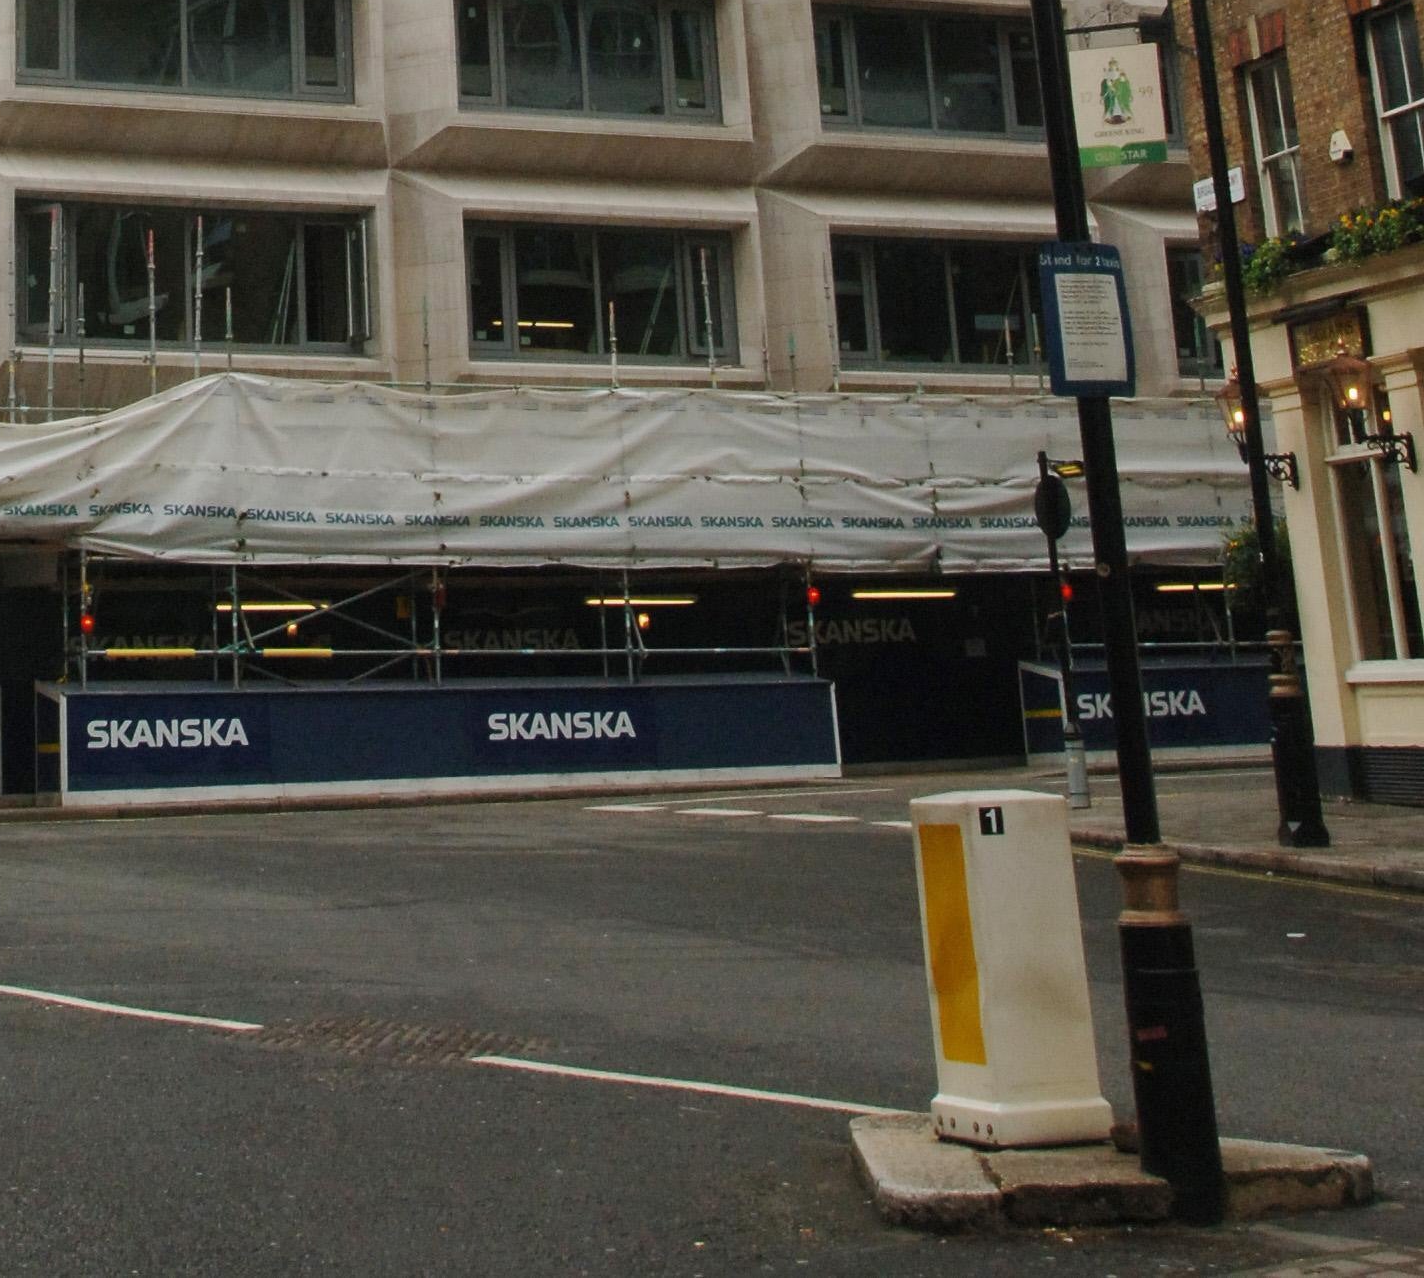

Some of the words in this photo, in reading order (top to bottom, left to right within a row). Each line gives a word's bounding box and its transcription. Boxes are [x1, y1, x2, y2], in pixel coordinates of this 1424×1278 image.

[1120, 149, 1148, 160] STAR
[163, 503, 237, 519] SKANSKA
[245, 508, 316, 523] SKANSKA
[325, 512, 395, 525] SKANSKA
[404, 514, 470, 527] SKANSKA
[479, 515, 544, 527] SKANSKA
[553, 515, 620, 527] SKANSKA
[628, 515, 693, 527] SKANSKA
[700, 516, 764, 527] SKANSKA
[771, 516, 834, 528] SKANSKA
[841, 516, 904, 529] SKANSKA
[912, 516, 972, 528] SKANSKA
[980, 516, 1039, 528] SKANSKA
[1177, 515, 1234, 527] SKANSKA
[786, 617, 917, 646] SKANSKA
[1077, 689, 1208, 721] SKSKA
[86, 718, 249, 749] SKANSKA
[488, 710, 637, 741] SKANSKA
[985, 808, 998, 834] 1
